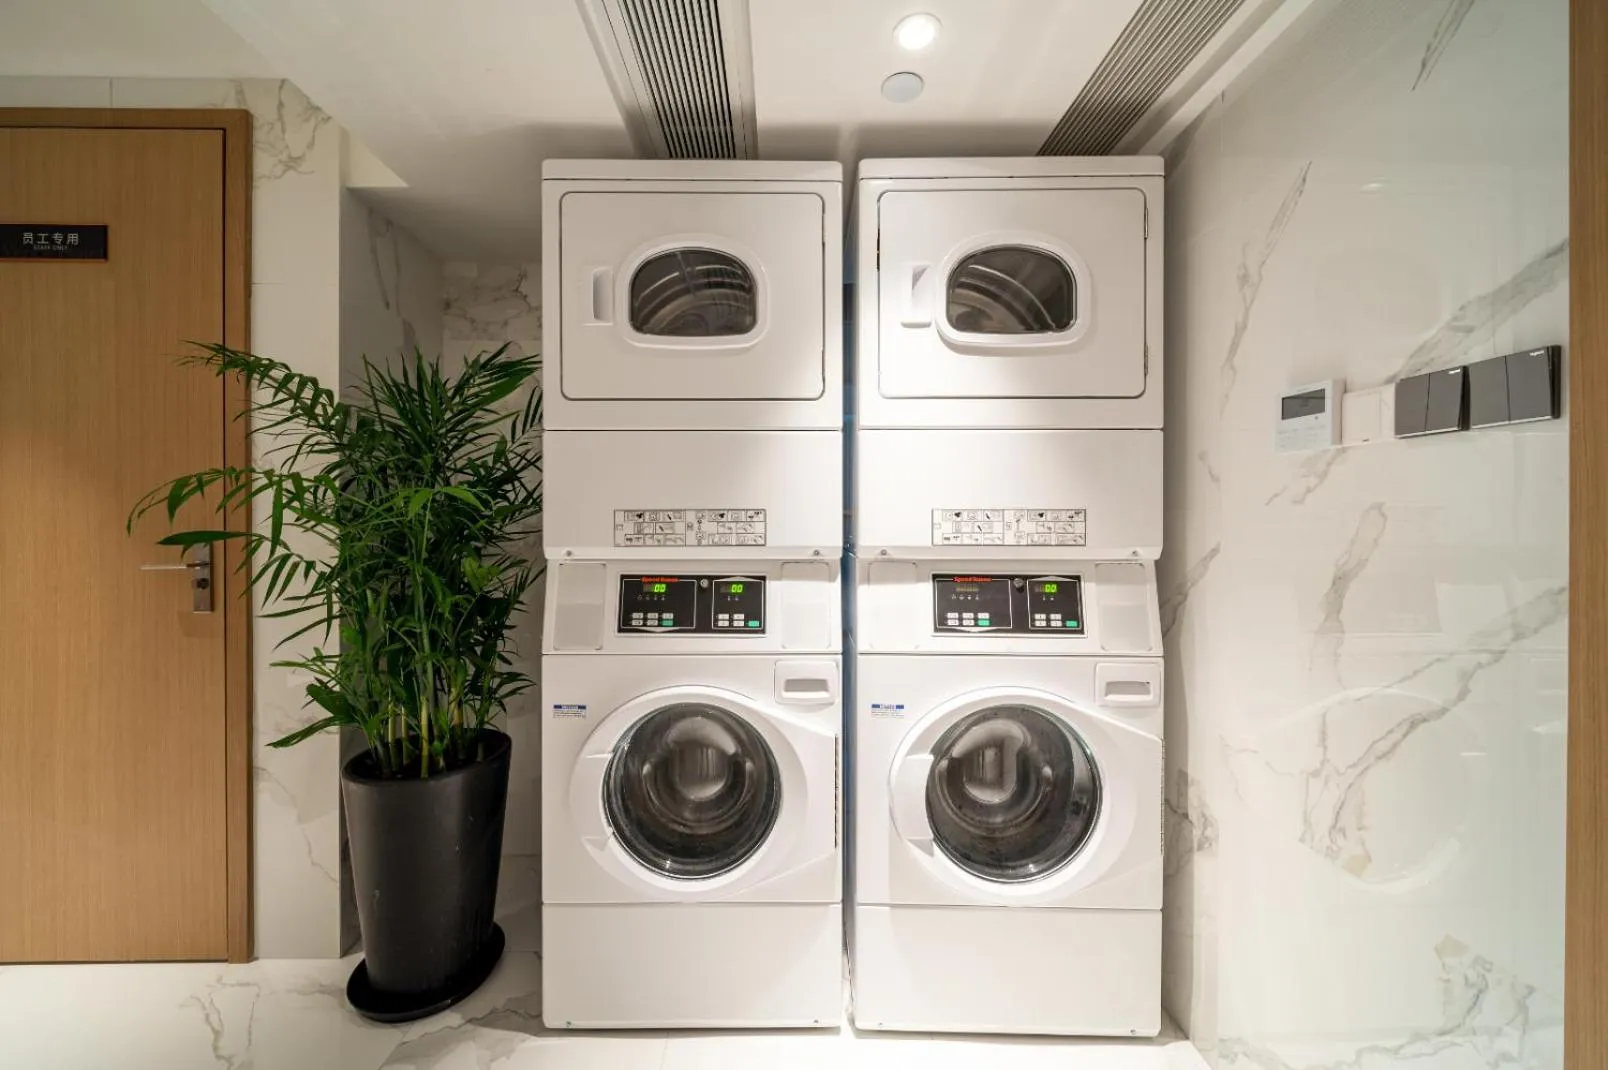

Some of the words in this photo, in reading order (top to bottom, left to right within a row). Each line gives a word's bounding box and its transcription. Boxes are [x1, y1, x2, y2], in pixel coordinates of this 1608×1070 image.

[23, 232, 79, 245] 员工专用
[654, 583, 666, 593] 00
[731, 583, 744, 593] 00
